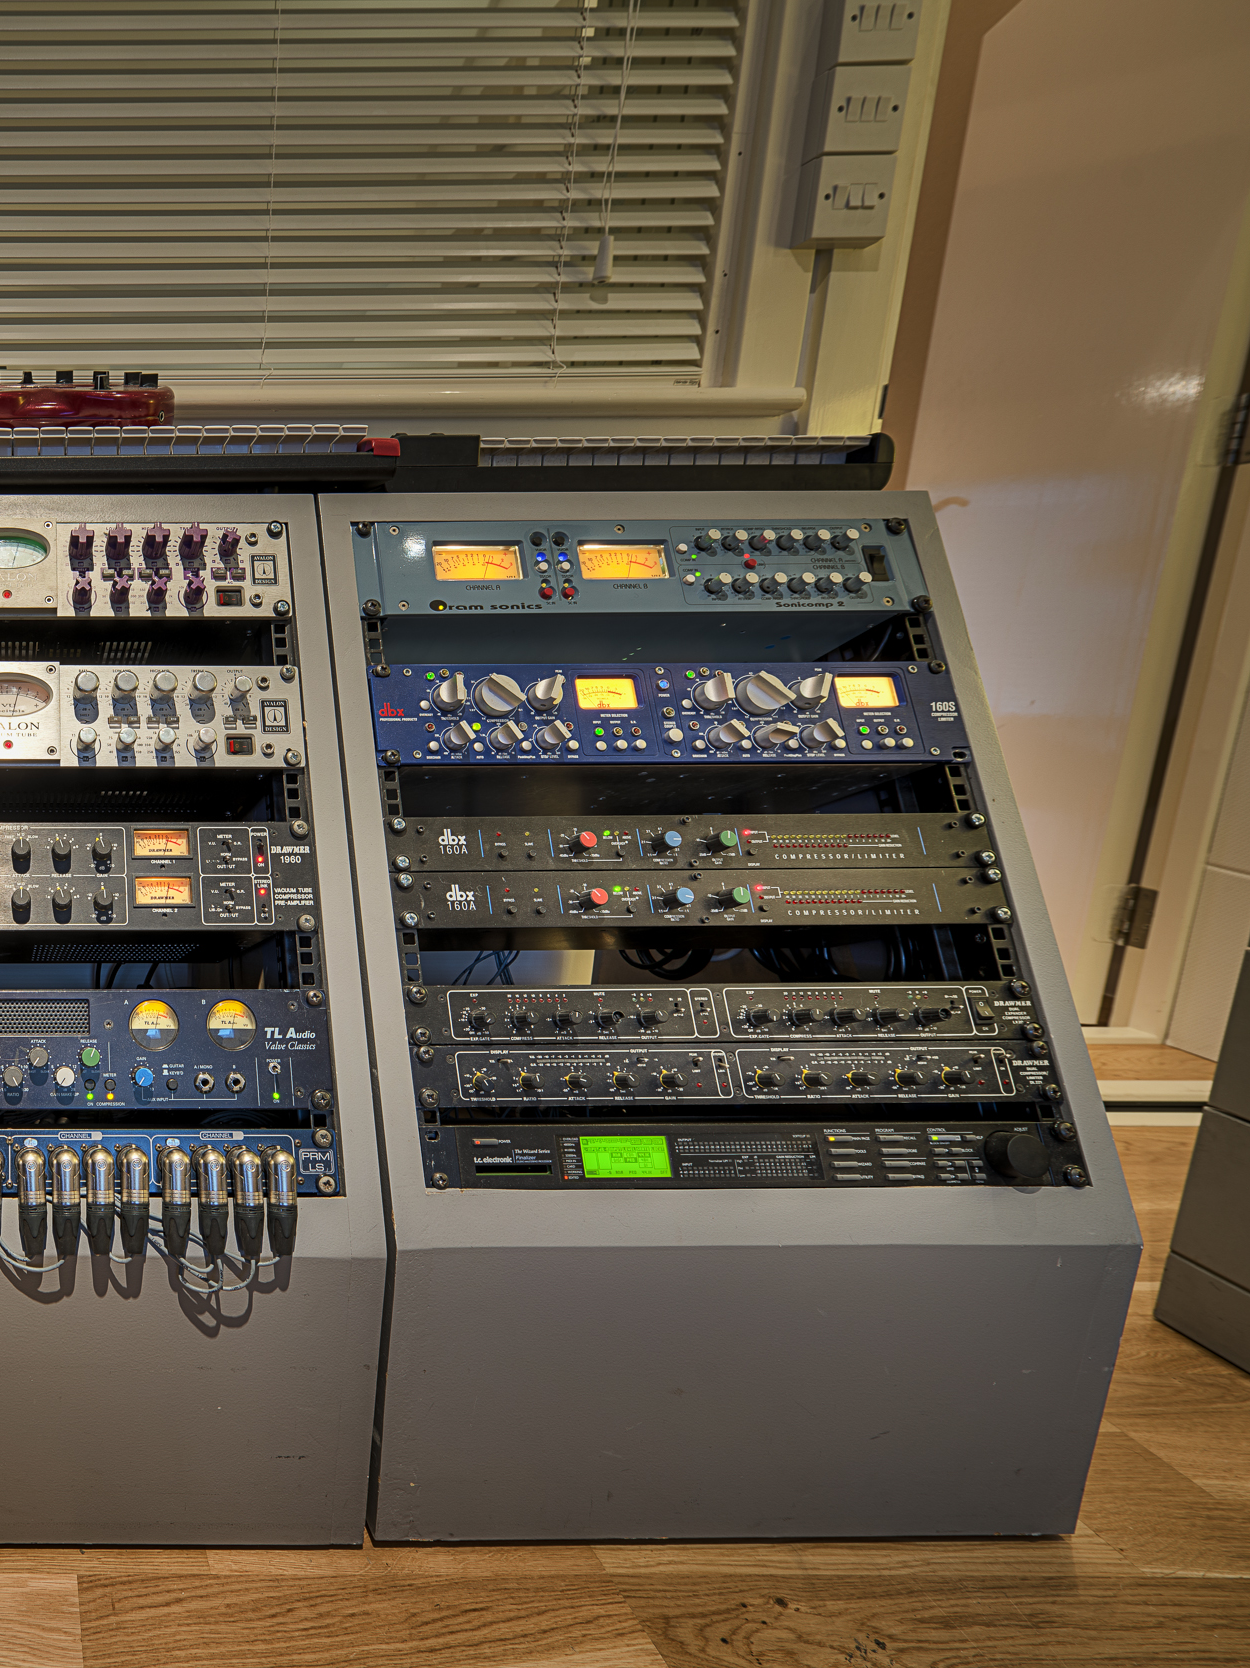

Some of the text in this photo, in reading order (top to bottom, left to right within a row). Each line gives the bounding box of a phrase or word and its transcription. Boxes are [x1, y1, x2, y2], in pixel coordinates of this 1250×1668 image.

[490, 601, 543, 610] sonics
[775, 601, 834, 609] Sonicomp
[378, 703, 404, 717] dbx
[930, 701, 955, 711] 160S
[438, 829, 466, 845] dbx
[270, 845, 310, 854] DRAWMER
[439, 846, 468, 855] 160A
[279, 856, 302, 864] 1960
[446, 885, 474, 901] dbx
[447, 902, 476, 911] 160A
[264, 1028, 285, 1039] TL
[264, 1041, 316, 1050] Valve Classics
[301, 1152, 330, 1162] PRM
